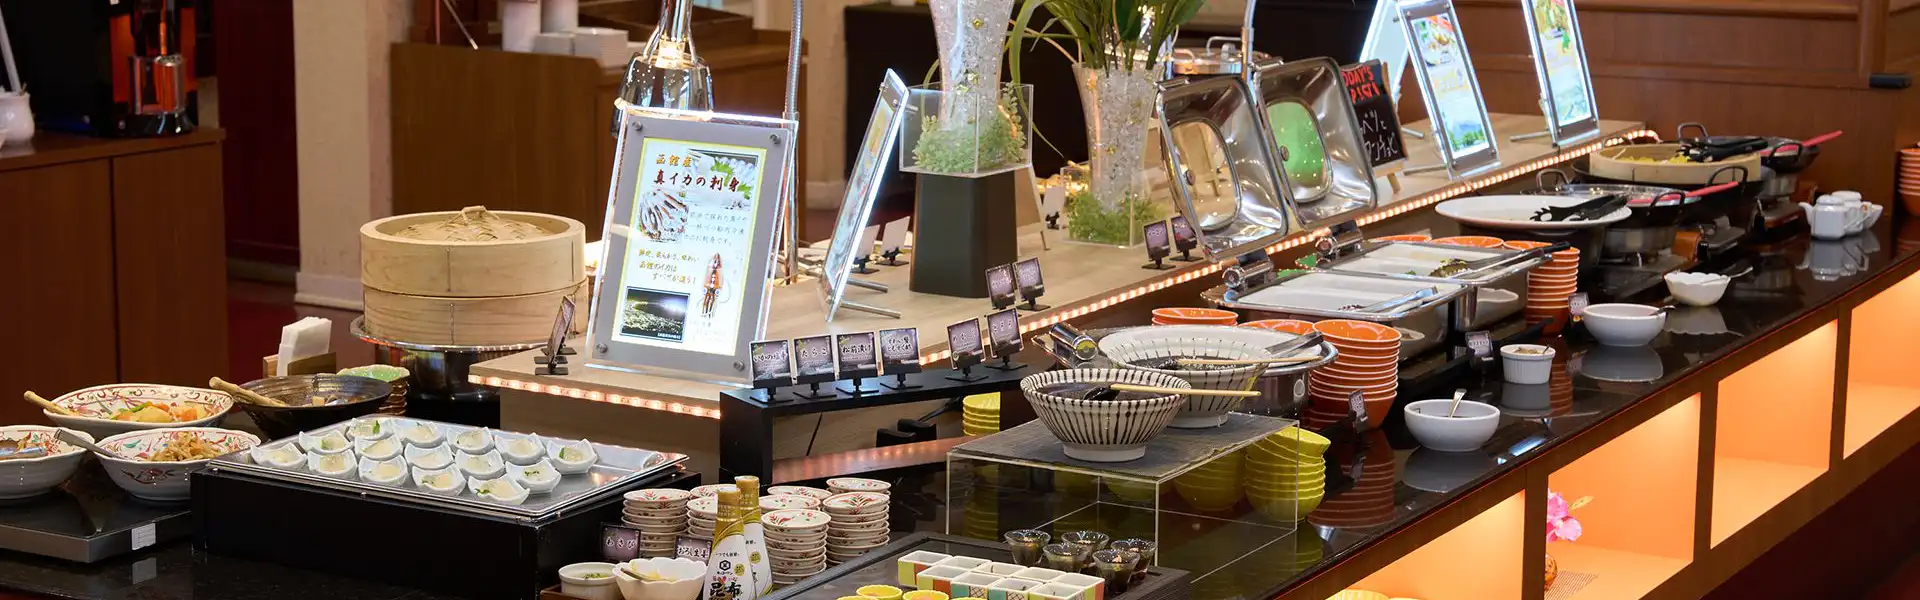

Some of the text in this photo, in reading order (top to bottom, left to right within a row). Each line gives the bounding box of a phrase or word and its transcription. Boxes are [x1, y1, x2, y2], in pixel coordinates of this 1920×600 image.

[1341, 66, 1374, 87] ODAY'S
[654, 169, 740, 192] 真イカの刺身
[801, 348, 828, 358] たらこ
[606, 537, 637, 549] わさび
